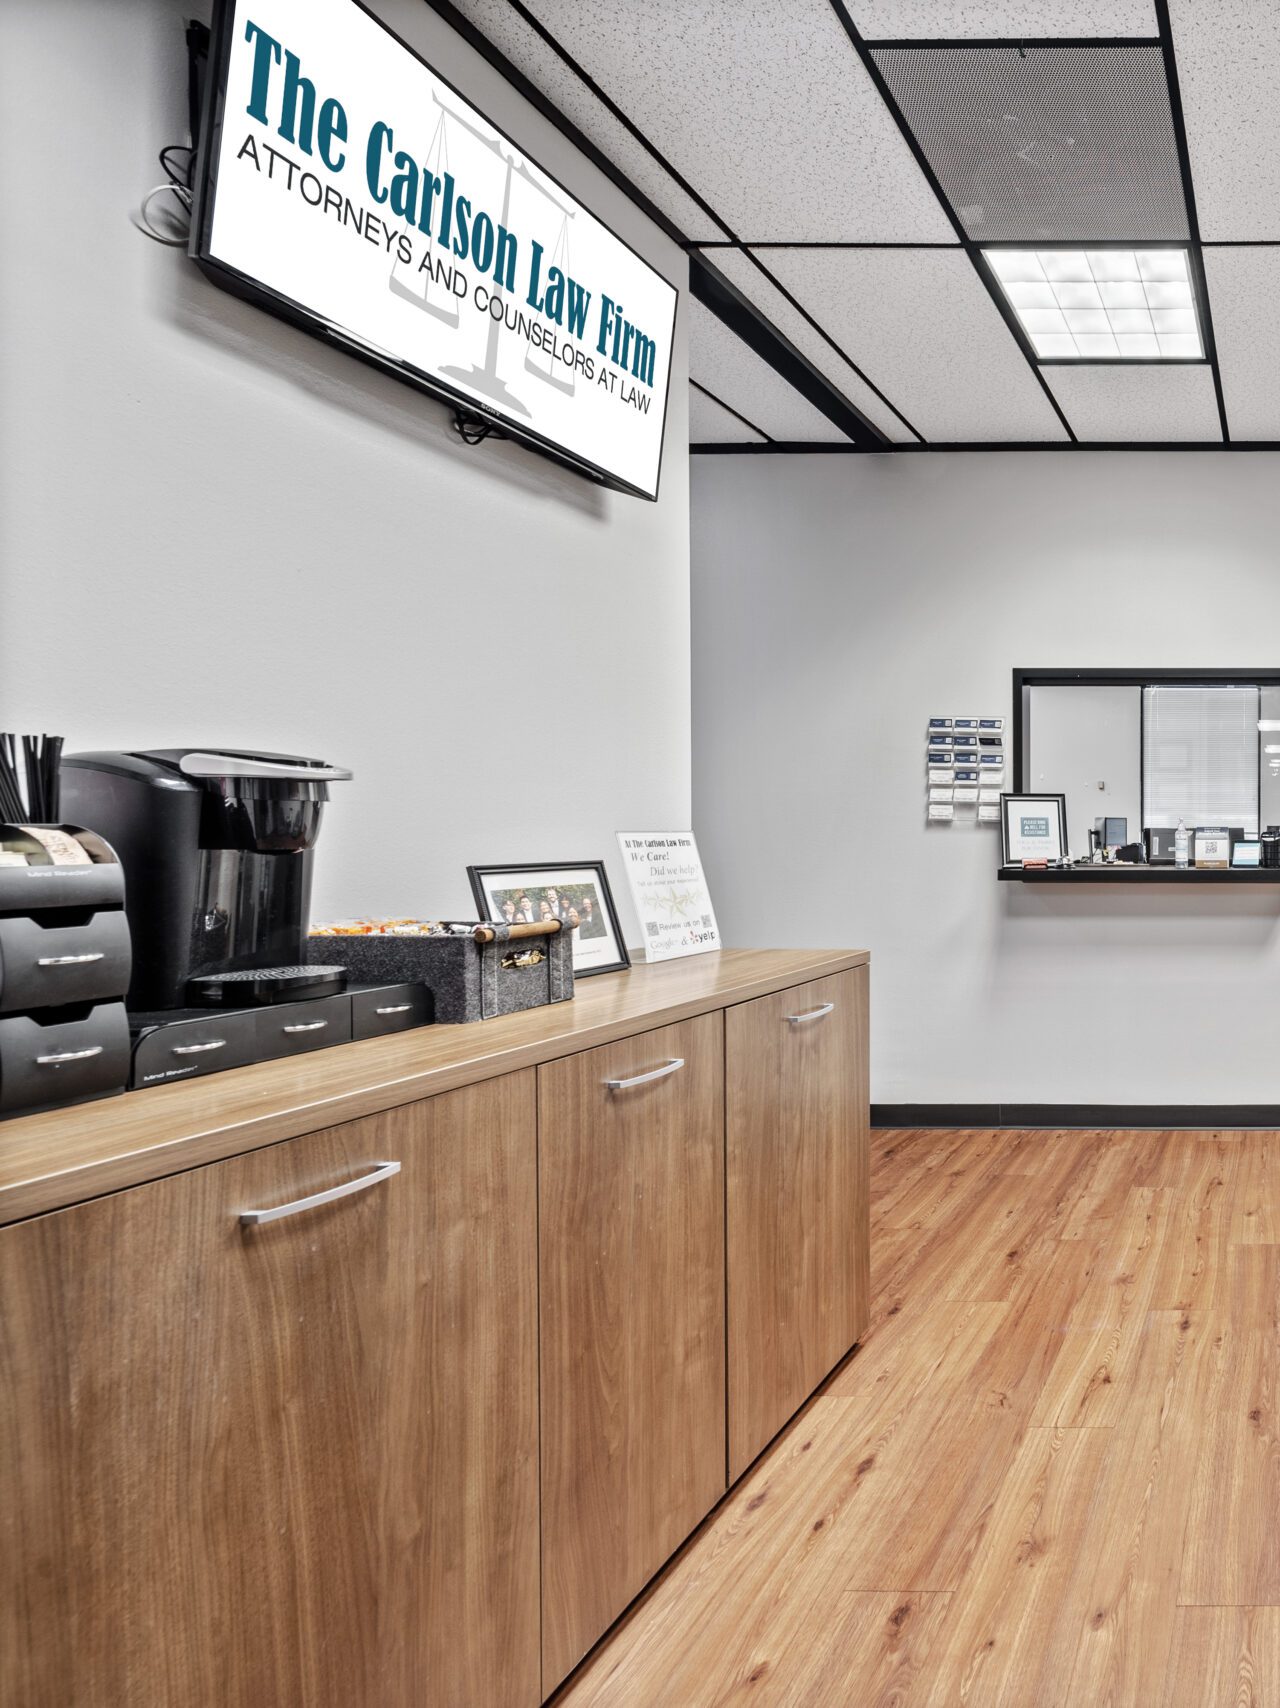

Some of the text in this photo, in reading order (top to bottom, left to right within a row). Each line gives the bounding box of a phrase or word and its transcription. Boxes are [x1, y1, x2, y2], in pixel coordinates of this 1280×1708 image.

[245, 20, 656, 388] The Carlson Law Firm
[237, 134, 651, 415] ATTORNEYS AND COUNSELORS AT LAW
[480, 402, 501, 418] SONY
[632, 839, 643, 848] The
[644, 839, 666, 848] Carlson
[666, 839, 677, 847] Law
[678, 838, 692, 847] Firm
[631, 851, 670, 862] We Care!
[650, 865, 665, 877] Did
[667, 867, 678, 875] we
[659, 922, 682, 931] Review
[693, 919, 701, 927] on
[698, 930, 716, 943] yelp
